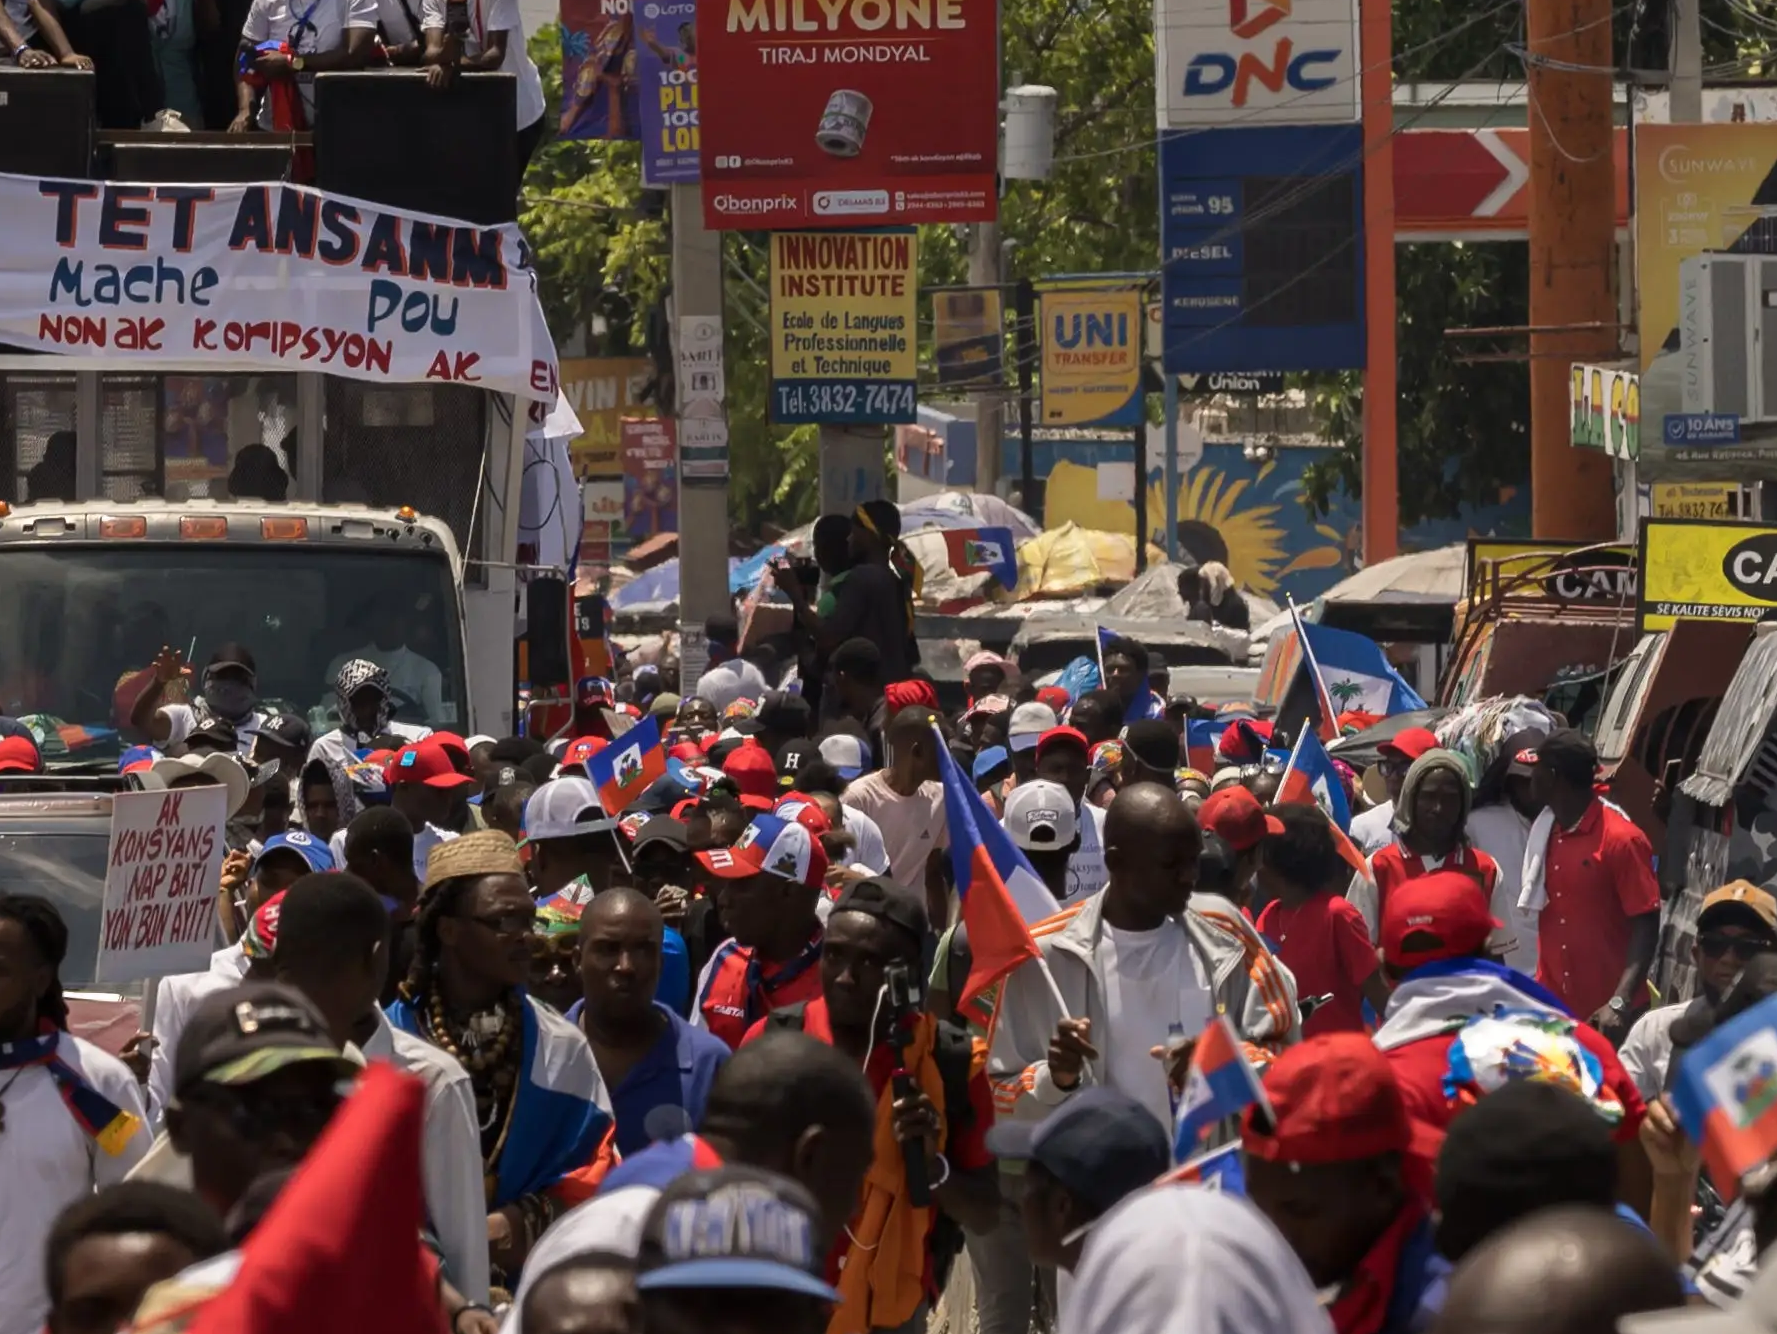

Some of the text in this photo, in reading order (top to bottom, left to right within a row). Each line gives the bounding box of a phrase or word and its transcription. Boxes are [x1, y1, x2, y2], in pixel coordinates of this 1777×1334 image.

[660, 2, 696, 16] LOTO
[757, 44, 931, 65] TIRAJ MONDYAL
[1183, 36, 1343, 107] DNC
[1208, 196, 1234, 215] 95
[38, 180, 509, 290] TET ANSANM
[778, 234, 910, 271] INNOVATION
[1172, 246, 1233, 260] DIESEL
[48, 255, 220, 308] Mache
[780, 274, 906, 298] INSTITUTE
[782, 310, 906, 333] Ecole de Langues
[1054, 311, 1128, 349] UNI
[784, 332, 907, 353] Professionnelle
[791, 355, 892, 377] et Technique
[1052, 351, 1128, 367] TRANSFER
[1208, 375, 1260, 391] Union
[808, 383, 916, 415] 3832-7474
[1686, 417, 1736, 432] 10 ANS
[1671, 604, 1711, 617] KALITE
[785, 753, 801, 770] H
[156, 792, 184, 827] AK
[111, 825, 216, 868] KONSYANS
[127, 862, 208, 903] NAP BATI
[104, 903, 136, 952] YON
[134, 901, 172, 951] BON
[170, 896, 217, 944] AYITI
